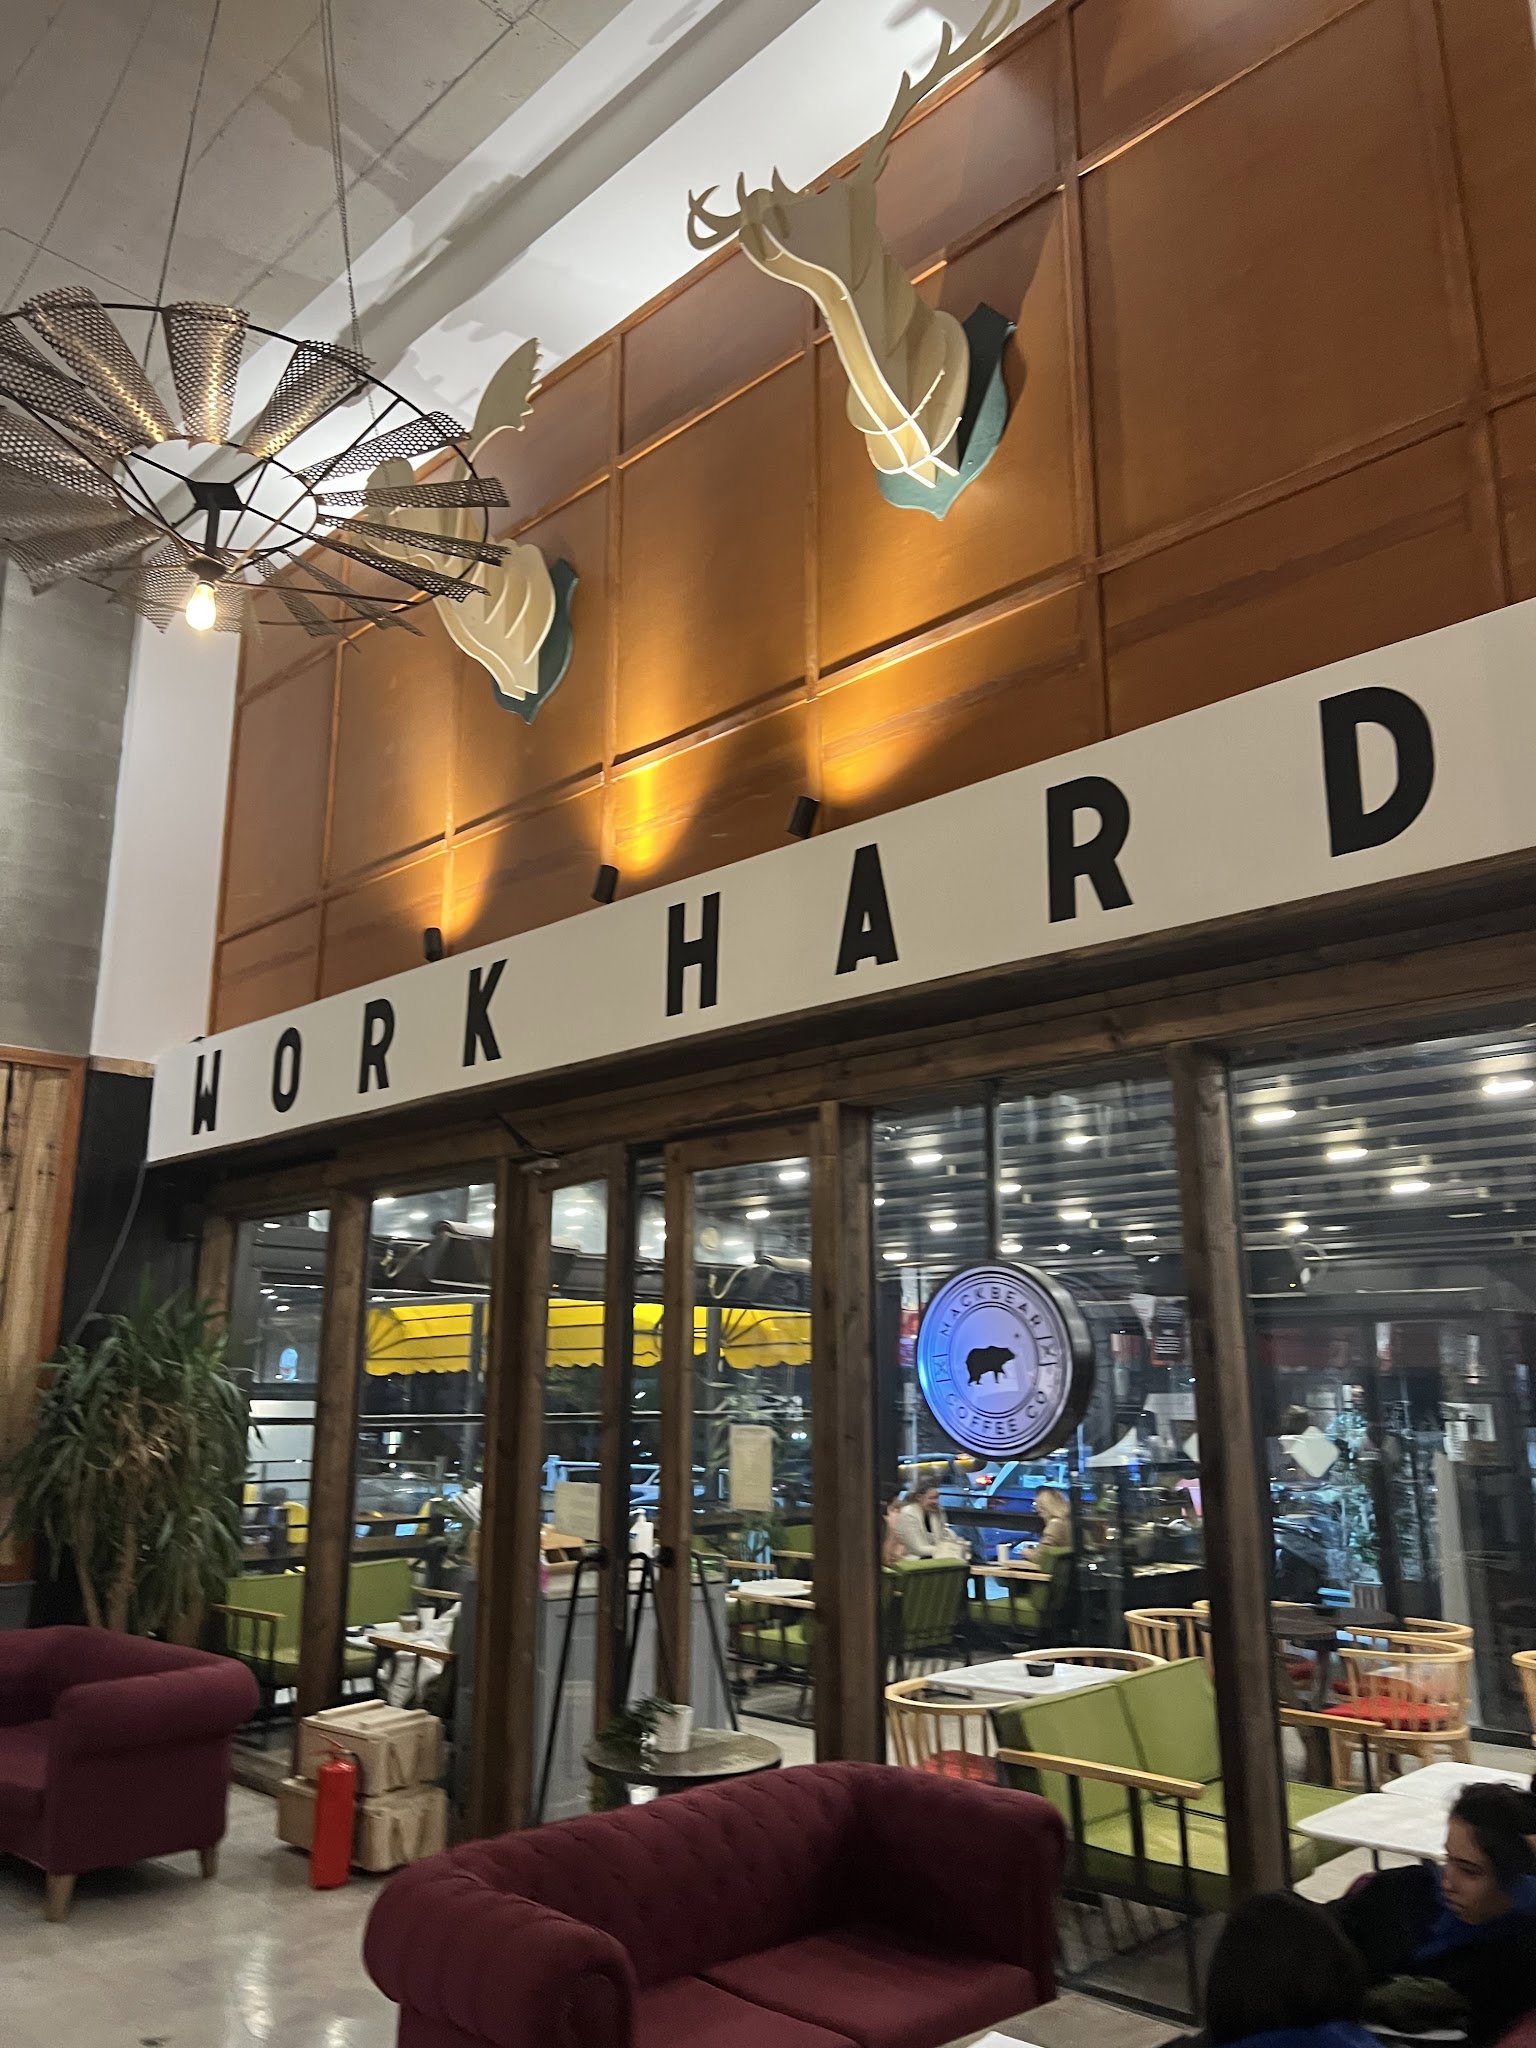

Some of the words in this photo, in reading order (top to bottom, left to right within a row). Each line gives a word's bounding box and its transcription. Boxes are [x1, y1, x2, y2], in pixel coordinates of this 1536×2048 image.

[191, 959, 507, 1135] WORK
[665, 686, 1435, 1017] HARD
[940, 1286, 1042, 1337] MACKBEAR
[946, 1392, 1018, 1435] COFFEE
